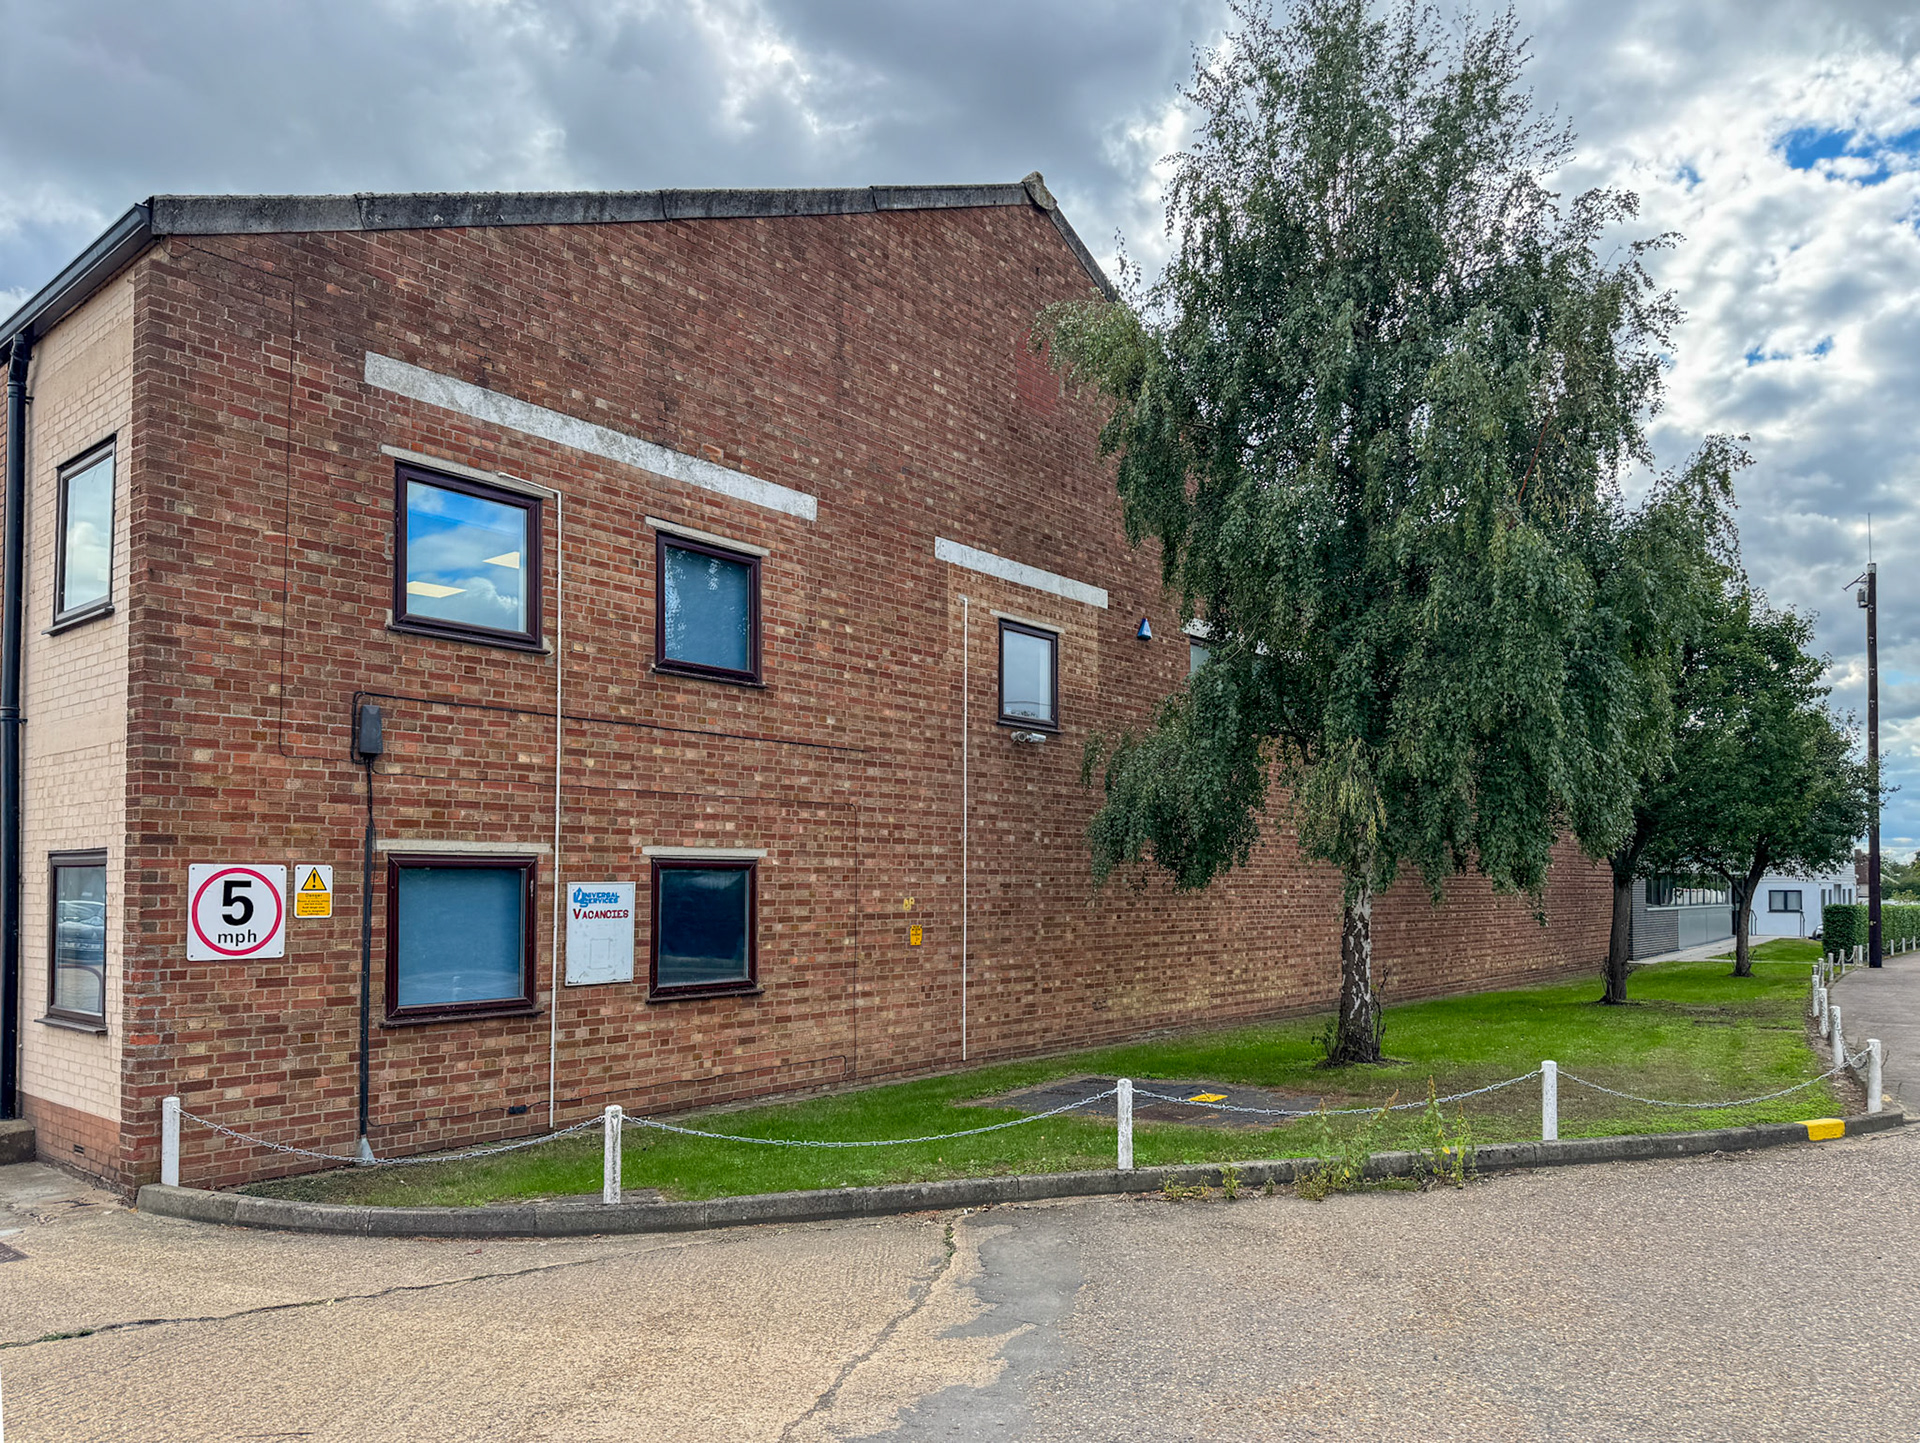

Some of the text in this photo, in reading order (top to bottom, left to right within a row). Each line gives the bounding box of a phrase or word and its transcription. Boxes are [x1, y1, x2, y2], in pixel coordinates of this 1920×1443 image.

[222, 880, 254, 926] 5
[573, 887, 619, 903] UNIVERSAL
[573, 908, 629, 919] VACANCIES
[217, 929, 257, 946] mph
